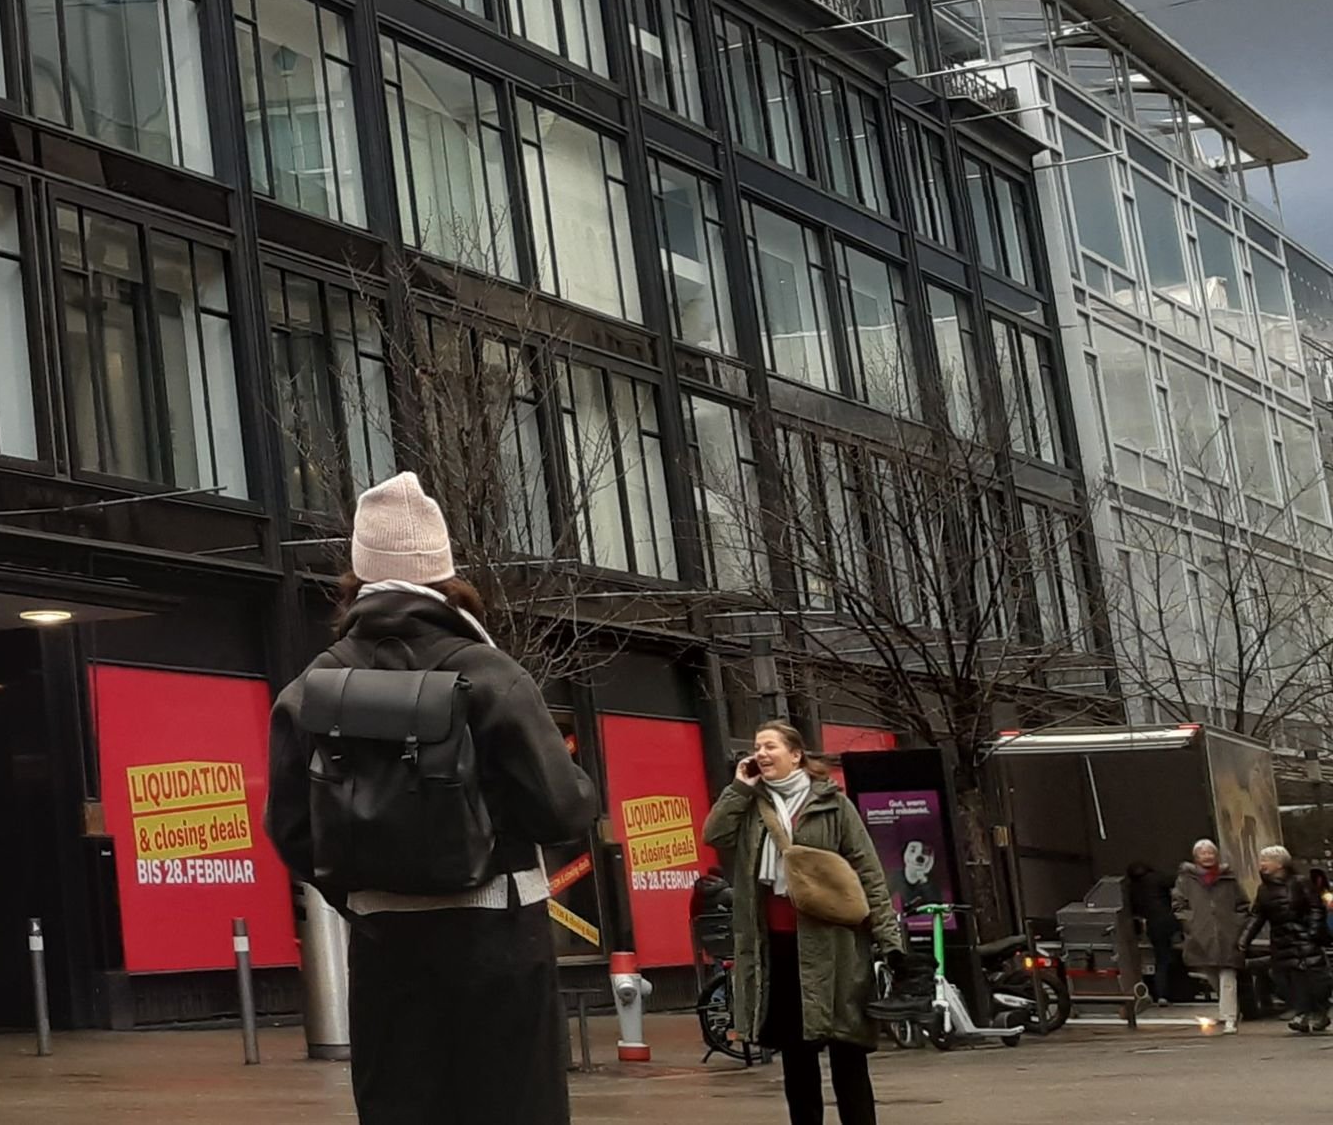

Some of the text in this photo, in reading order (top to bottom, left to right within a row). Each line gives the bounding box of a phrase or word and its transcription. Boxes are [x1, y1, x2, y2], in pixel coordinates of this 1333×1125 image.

[131, 764, 241, 807] LIQUIDATION
[624, 798, 689, 831] LIQUIDATION
[139, 813, 247, 853] & closing deals
[631, 835, 694, 866] & closing deals
[137, 859, 255, 884] BIS 28.FEBRUAR
[632, 870, 647, 891] BIS
